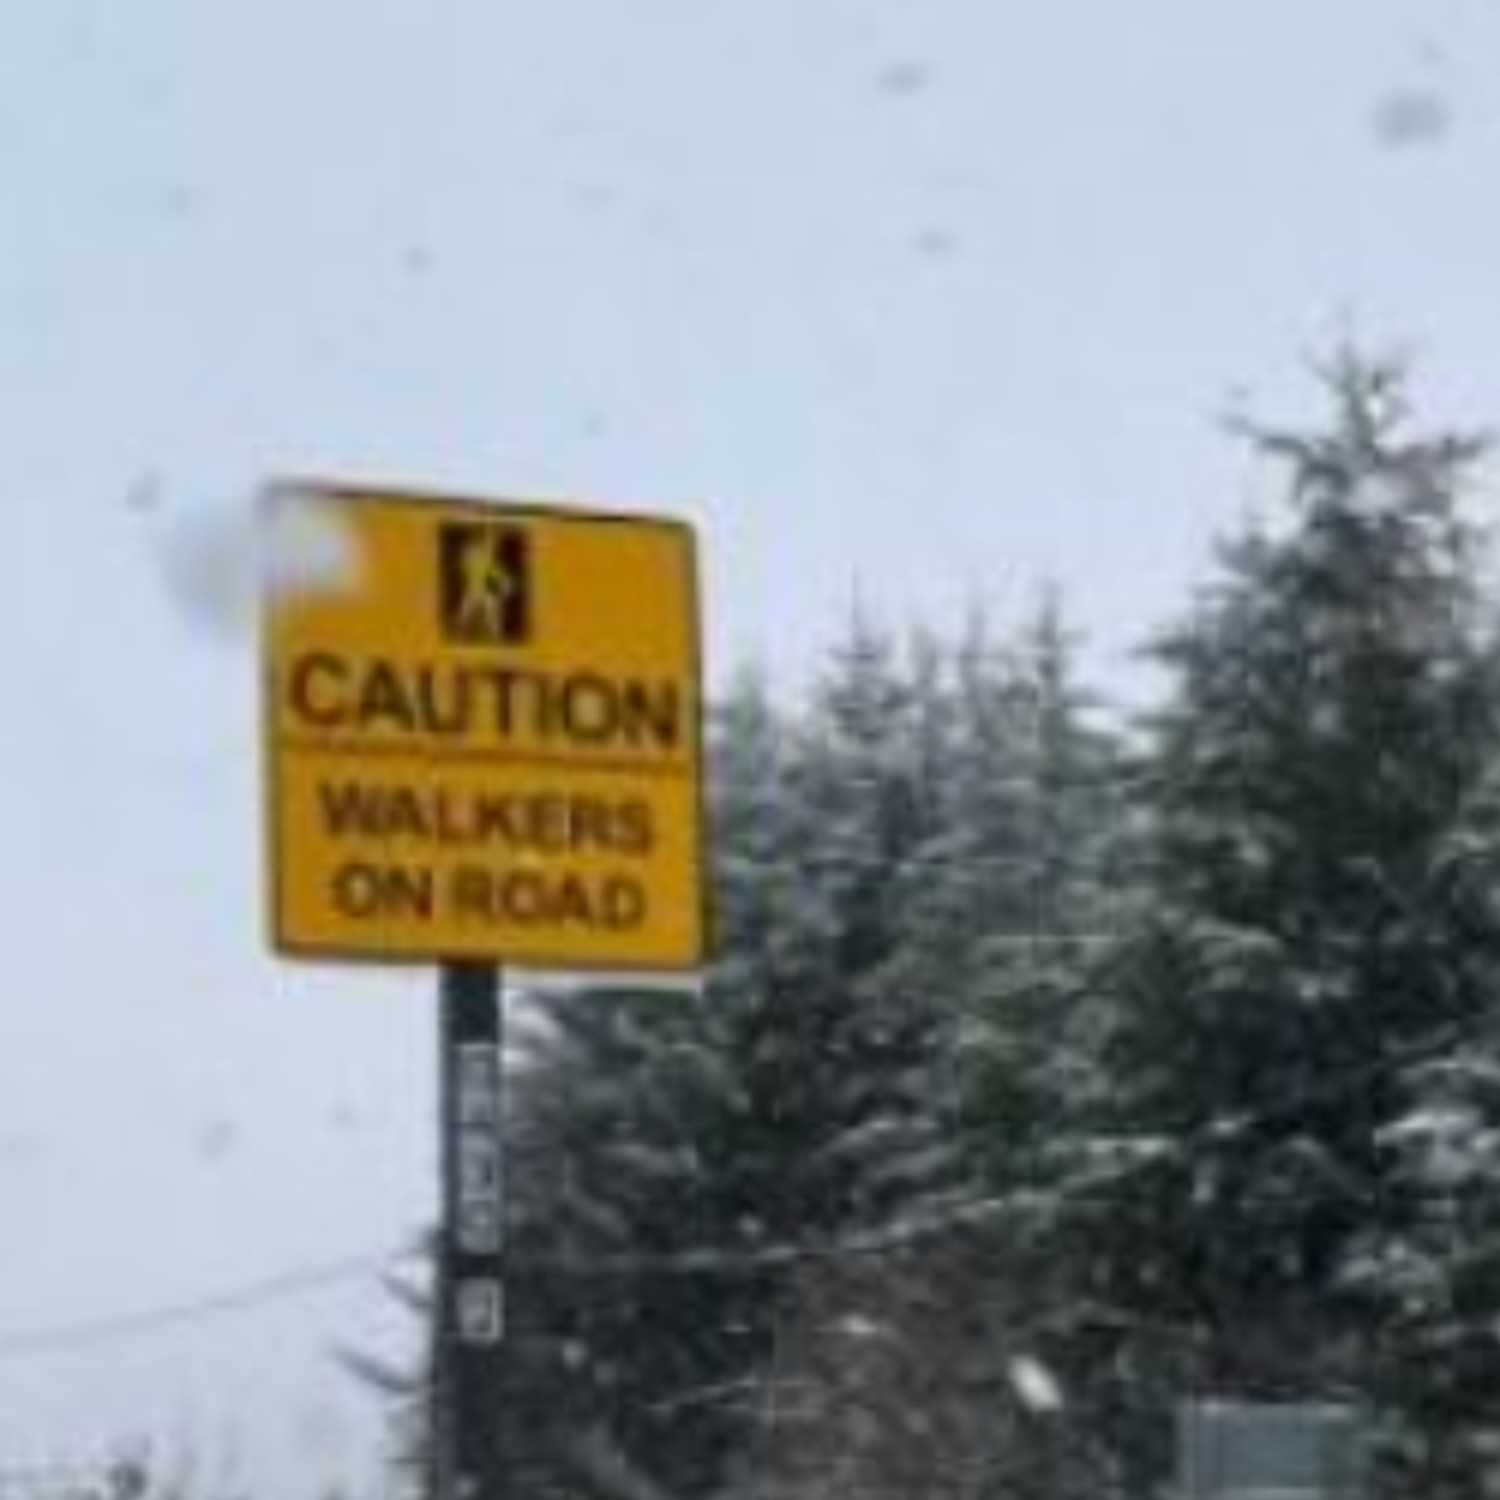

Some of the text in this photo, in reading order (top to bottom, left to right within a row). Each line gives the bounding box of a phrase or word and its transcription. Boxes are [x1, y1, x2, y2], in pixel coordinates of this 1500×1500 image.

[289, 652, 682, 747] CAUTION
[319, 780, 654, 856] WALKERS
[333, 860, 645, 929] ON ROAD
